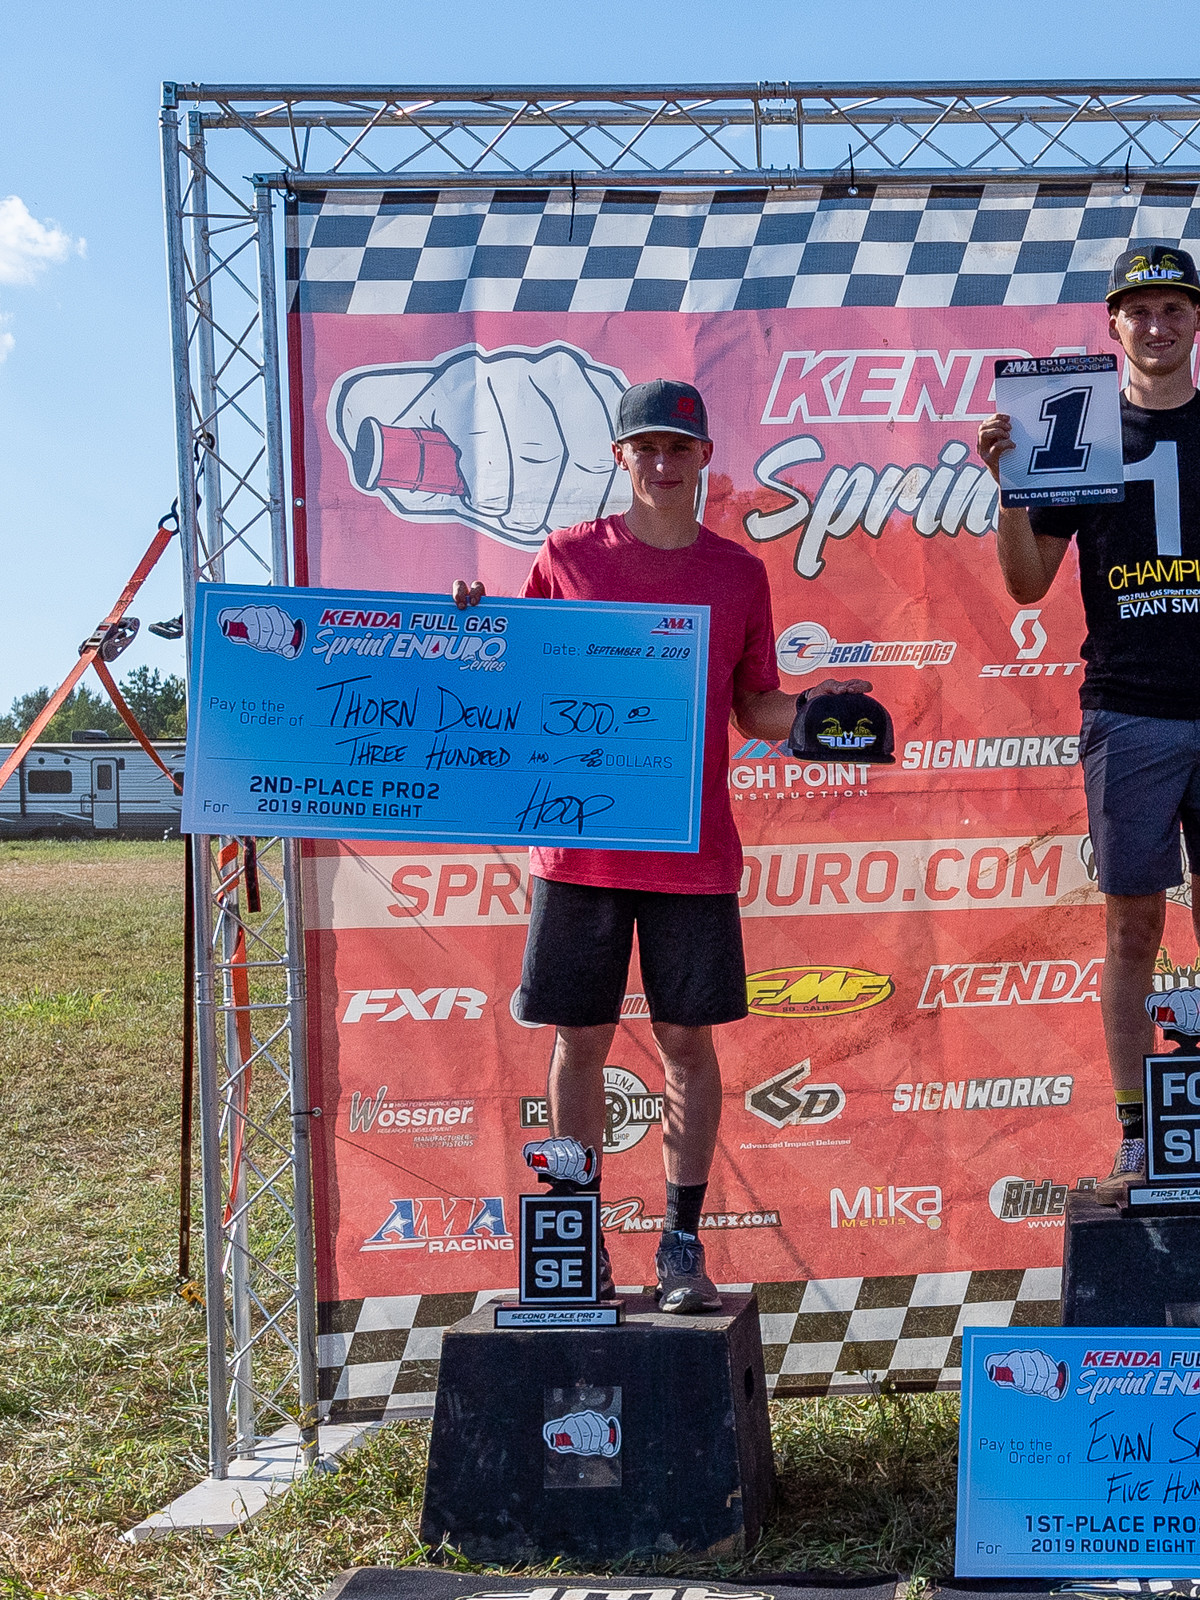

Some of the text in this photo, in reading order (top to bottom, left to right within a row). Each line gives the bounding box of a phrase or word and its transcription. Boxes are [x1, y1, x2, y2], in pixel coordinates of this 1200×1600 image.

[1002, 361, 1038, 374] AMA
[1067, 356, 1113, 365] REGIONAL
[1040, 363, 1114, 374] CHAMPIONSHIP
[1027, 386, 1093, 475] 1
[1050, 490, 1081, 498] SPRINT
[1082, 488, 1118, 496] ENDURO
[1124, 441, 1182, 557] 1
[1150, 589, 1163, 597] GAS
[1120, 598, 1167, 620] EVAN
[319, 609, 508, 634] KENDA FULL GAS
[653, 617, 694, 630] AMA
[312, 629, 508, 665] Sprint ENDURO
[543, 643, 581, 656] Date:
[661, 647, 691, 659] 2019
[978, 662, 1082, 678] SCOTT
[209, 697, 285, 713] Pay to the
[316, 675, 420, 728] THORN
[240, 712, 304, 726] Order of
[336, 732, 408, 766] THREE
[901, 736, 1081, 770] SIGNWORKS
[606, 754, 673, 769] DOLLARS
[785, 763, 871, 788] POINT
[250, 776, 440, 799] 2ND-PLACE PRO2
[203, 800, 229, 813] For
[257, 799, 422, 818] 2019 ROUND EIGHT
[341, 986, 488, 1023] FXR
[892, 1076, 1074, 1112] SIGNWORKS
[740, 1138, 851, 1150] Advanced Impact Defense
[1000, 1179, 1068, 1219] Ride
[364, 1197, 513, 1243] AMA
[535, 1210, 582, 1240] FG
[841, 1216, 907, 1228] Metals
[429, 1238, 514, 1253] RACING
[535, 1259, 583, 1288] SE
[511, 1312, 546, 1320] SECOND
[1082, 1351, 1161, 1368] KENDA
[1076, 1370, 1154, 1405] Sprint
[1086, 1410, 1154, 1463] EVAN
[979, 1438, 1053, 1454] Pay to the
[1009, 1451, 1072, 1464] Order of
[1106, 1472, 1154, 1504] FIVE
[1025, 1515, 1145, 1533] 1ST-PLACE
[977, 1542, 1002, 1555] For
[1031, 1539, 1196, 1553] 2019 ROUND EIGHT
